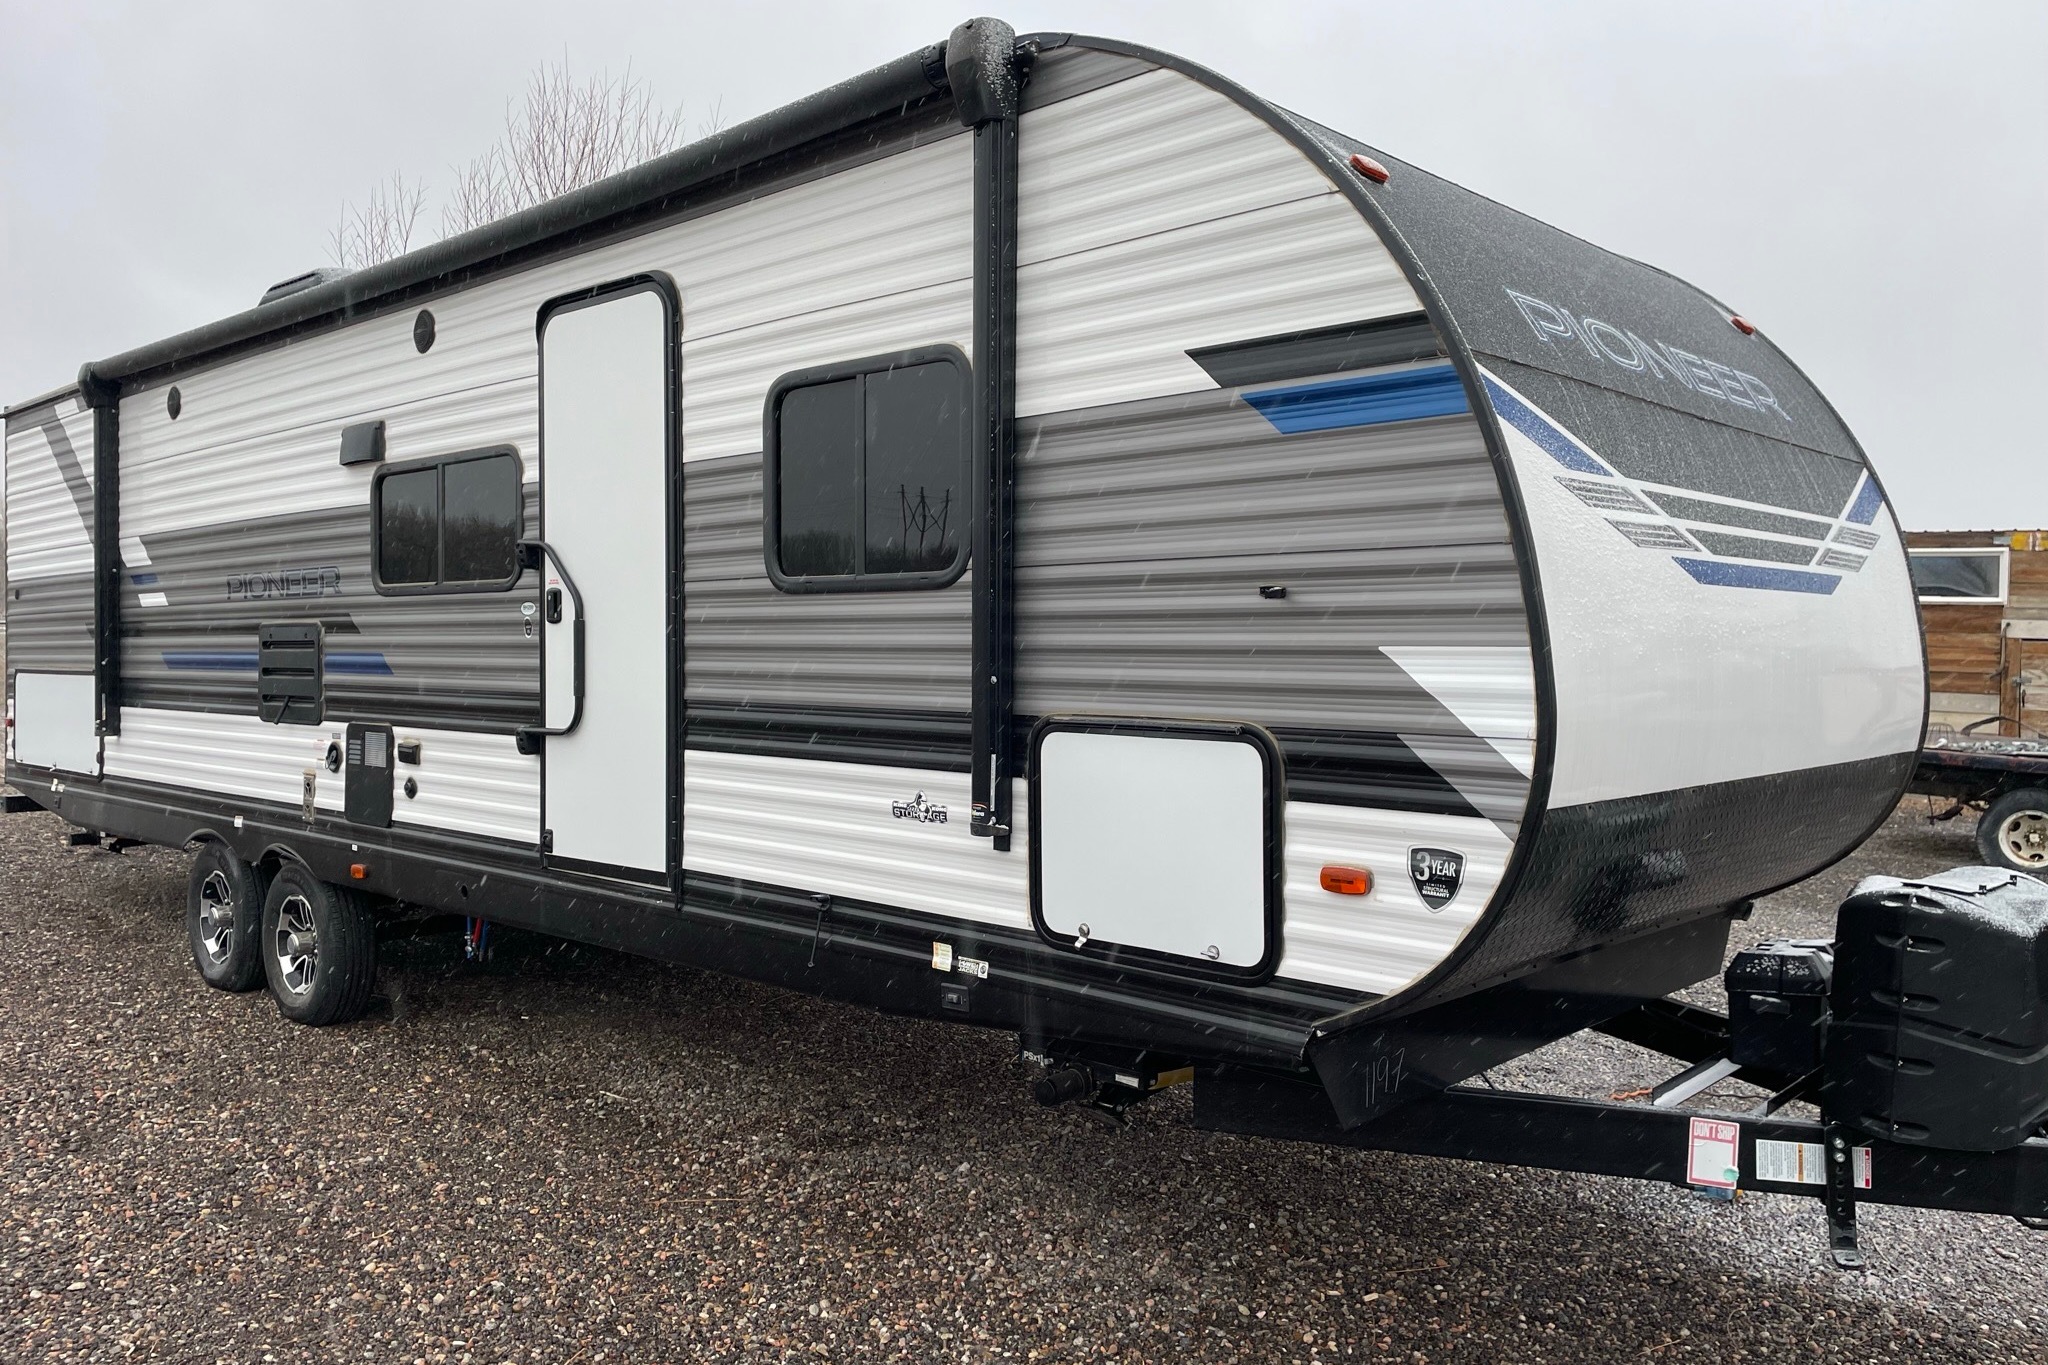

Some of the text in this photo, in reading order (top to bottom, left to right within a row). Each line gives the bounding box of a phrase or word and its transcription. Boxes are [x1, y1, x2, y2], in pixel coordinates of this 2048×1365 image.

[1506, 288, 1792, 422] PIONEER
[226, 566, 342, 600] PIONEER
[894, 808, 946, 821] STORAGE
[1415, 851, 1456, 880] 3 YEAR
[1693, 1121, 1736, 1141] DON'T SHIP
